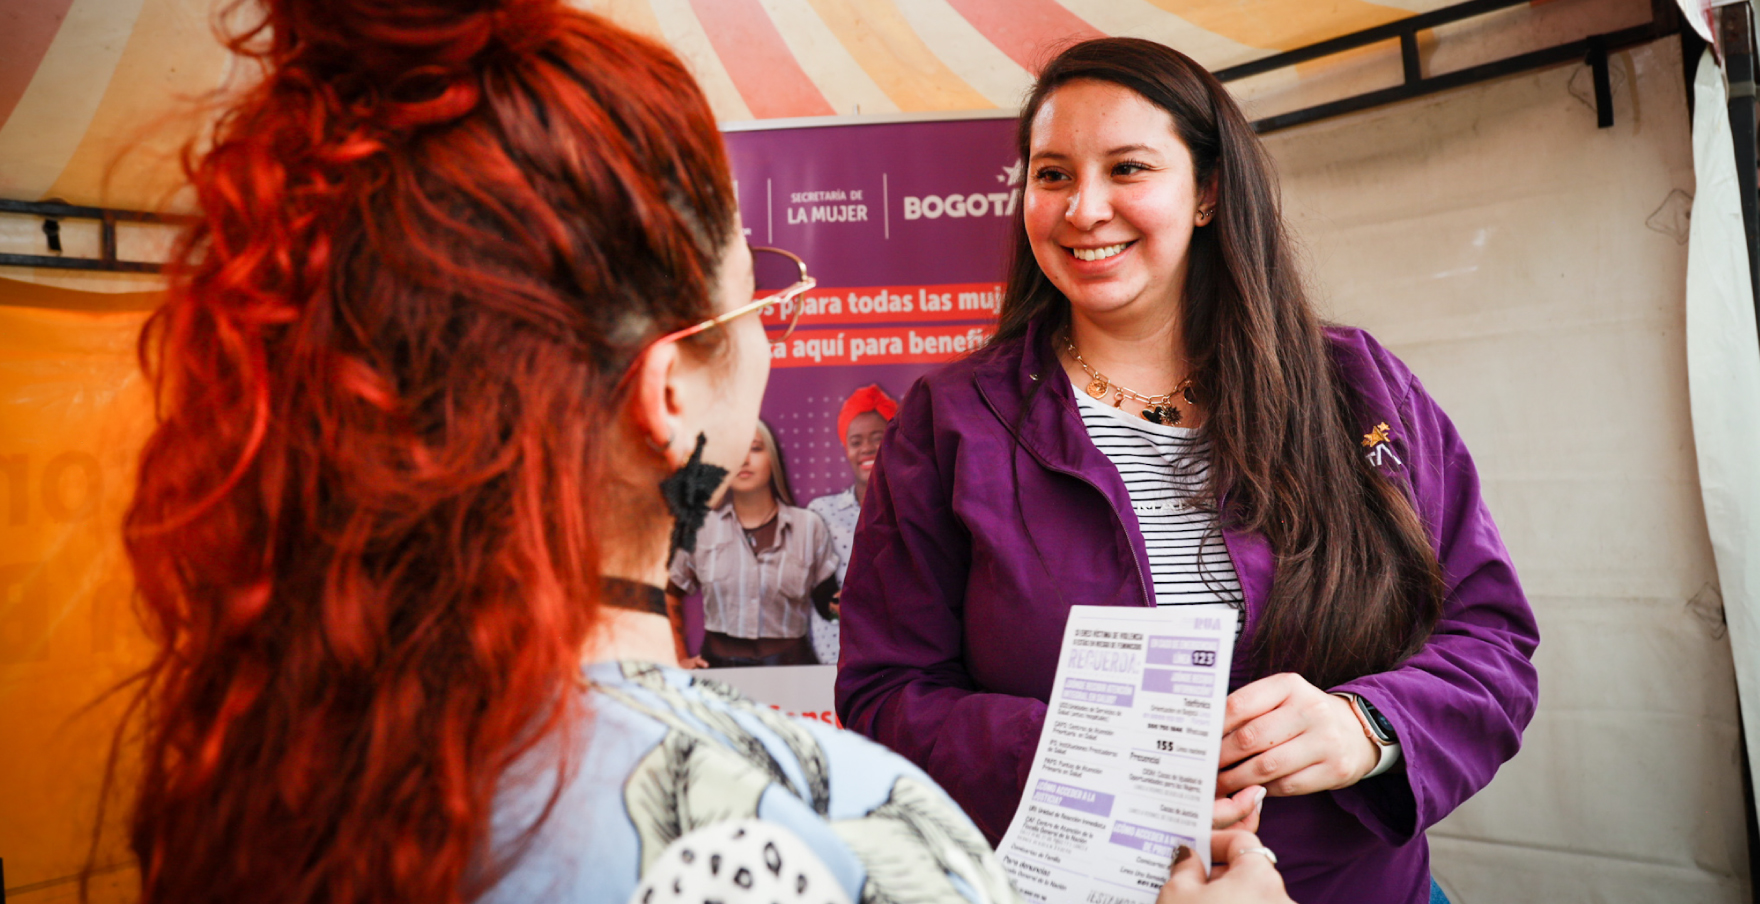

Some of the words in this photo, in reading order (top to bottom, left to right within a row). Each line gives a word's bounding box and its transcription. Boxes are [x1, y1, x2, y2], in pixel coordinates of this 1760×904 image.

[791, 189, 846, 203] SECRETARÍA
[850, 190, 863, 200] DE
[787, 208, 808, 224] LA
[812, 205, 868, 222] MUJER
[848, 290, 913, 313] todas
[919, 289, 952, 311] las
[793, 333, 845, 362] aquí
[850, 334, 902, 362] para
[1193, 651, 1215, 665] 123
[1157, 740, 1174, 751] 155
